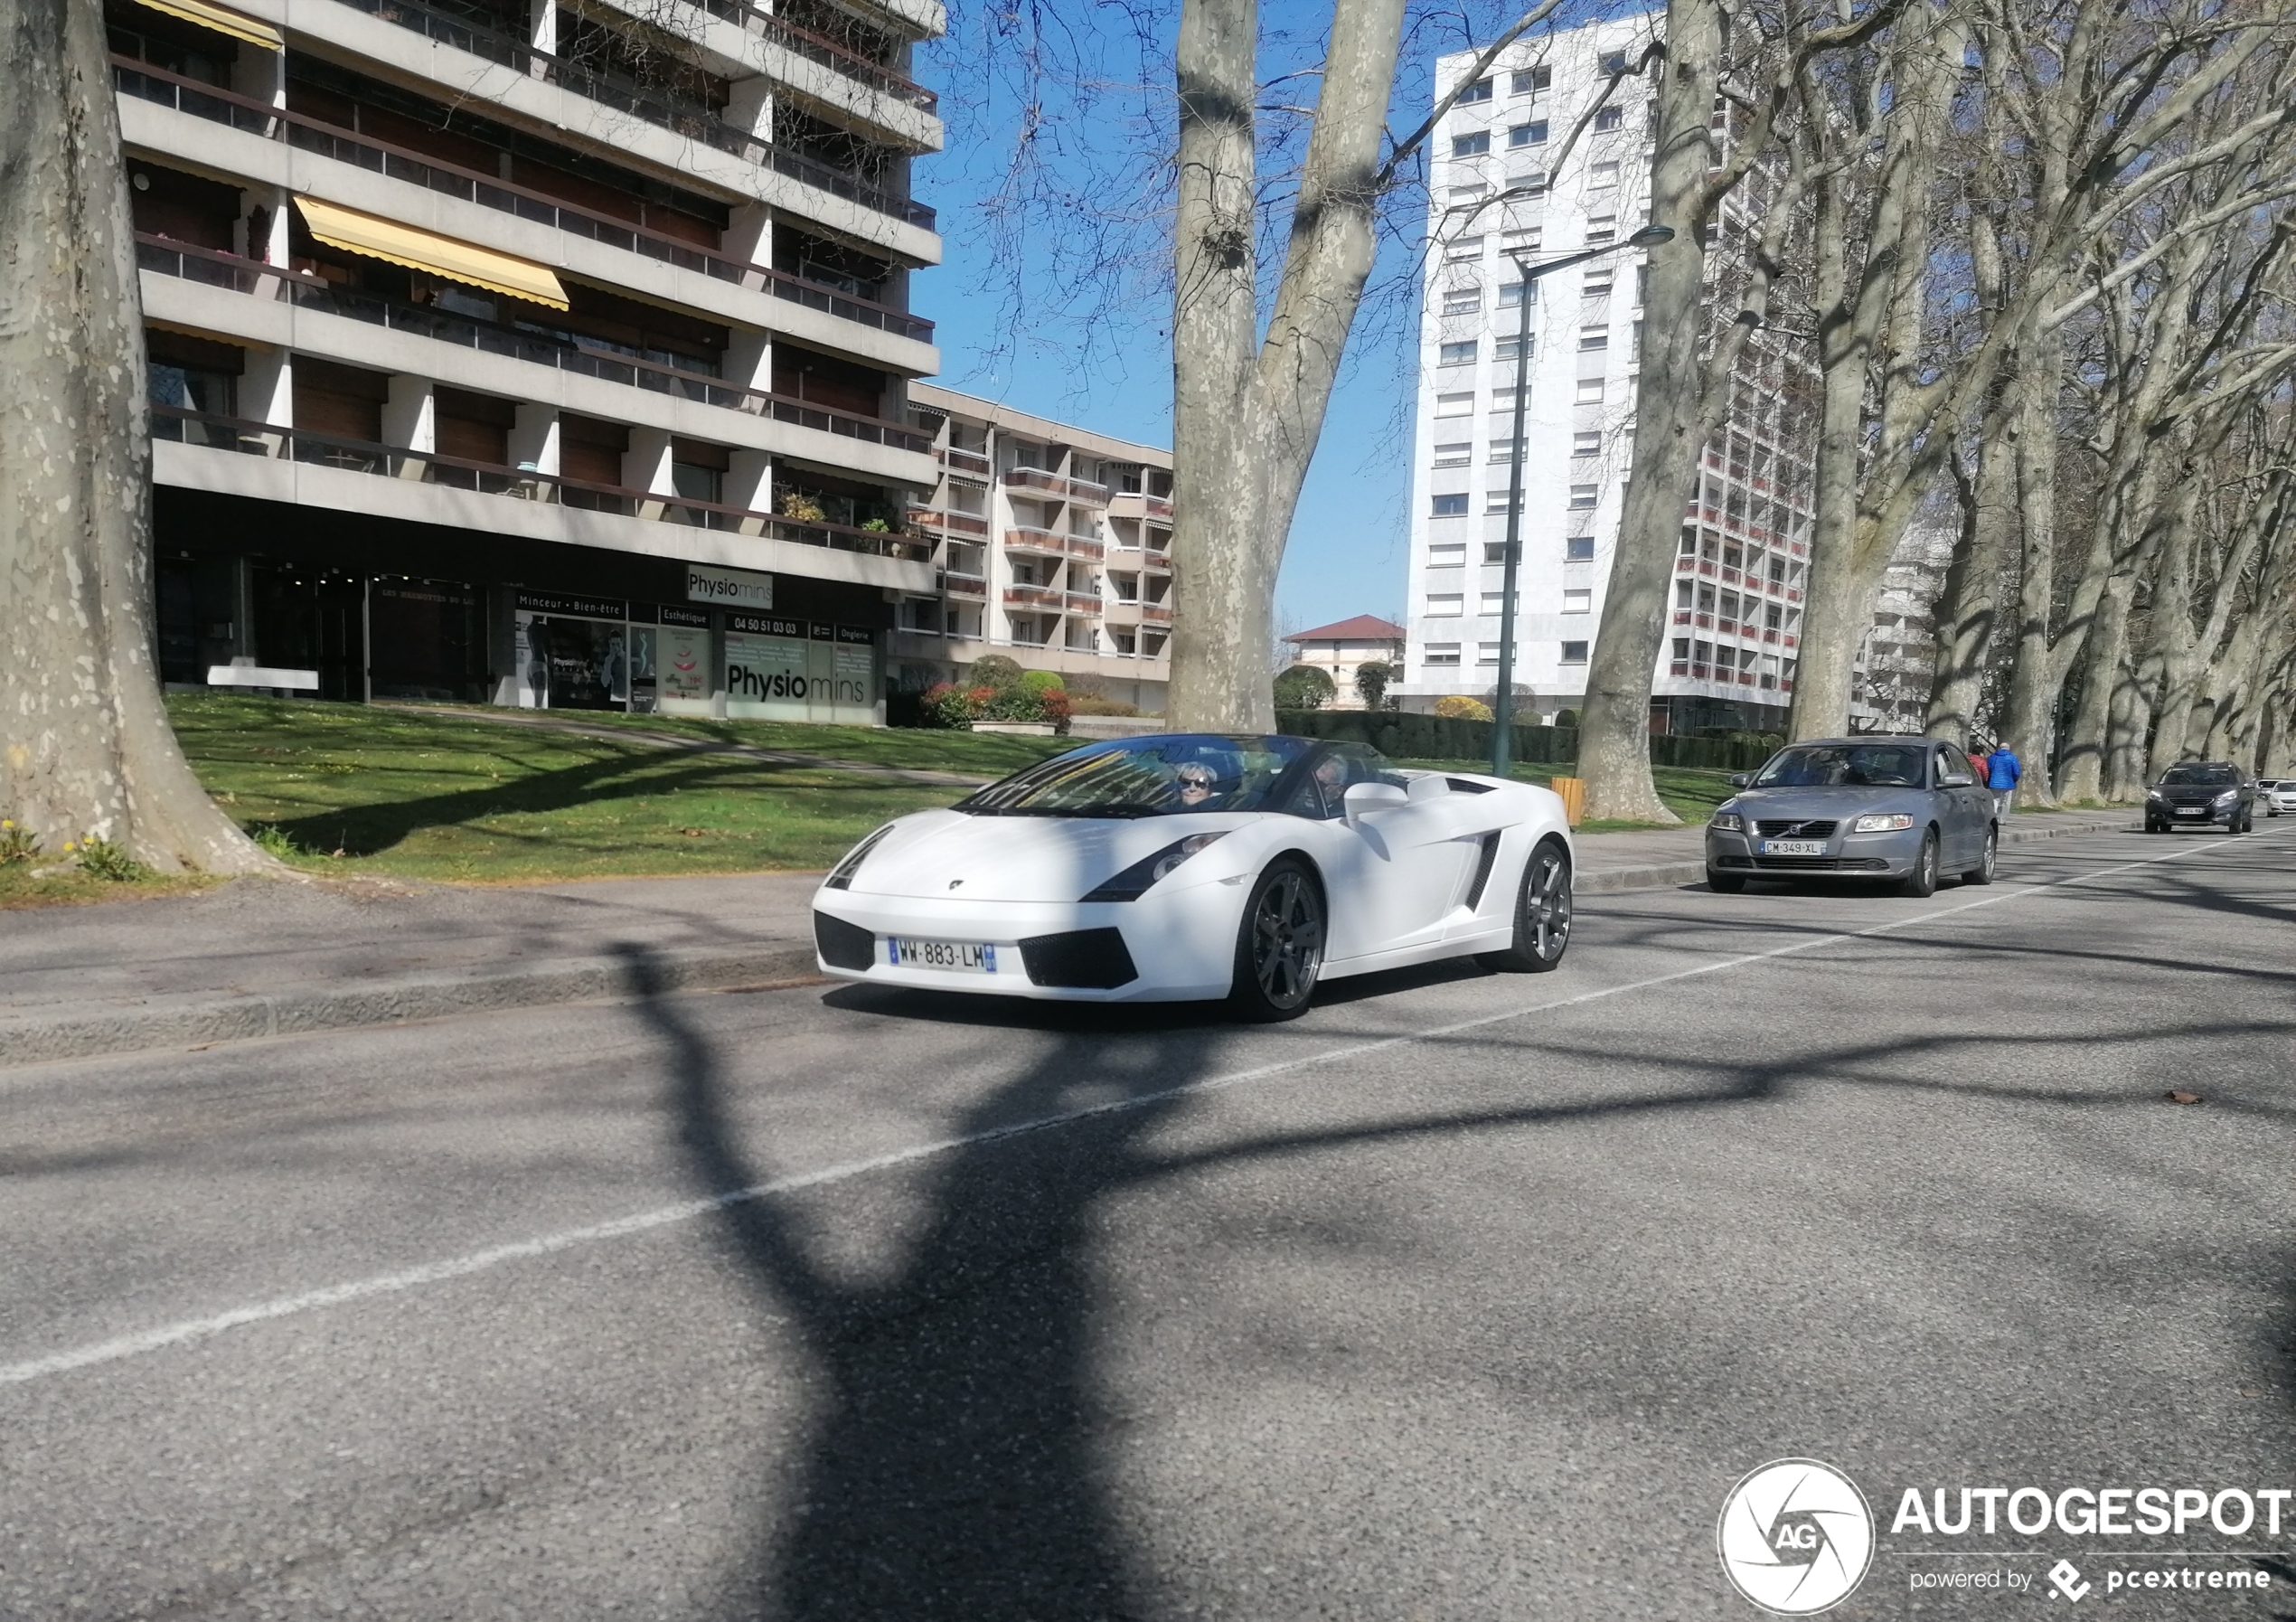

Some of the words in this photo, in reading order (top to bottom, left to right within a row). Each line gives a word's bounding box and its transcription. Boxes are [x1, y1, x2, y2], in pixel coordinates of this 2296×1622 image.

[689, 573, 772, 601] Physiomins
[519, 595, 561, 608] Minceur
[574, 601, 619, 615] Bien-être
[664, 608, 707, 624] Esthétique
[734, 617, 747, 629] 04
[748, 618, 759, 631] 50
[761, 620, 771, 632] 51
[773, 621, 785, 633] 03
[786, 623, 796, 635] 03
[841, 627, 870, 641] Onglerie
[729, 665, 864, 703] Physiomins
[1766, 843, 1818, 853] CM-349-XL
[899, 939, 984, 967] WW-883-LM
